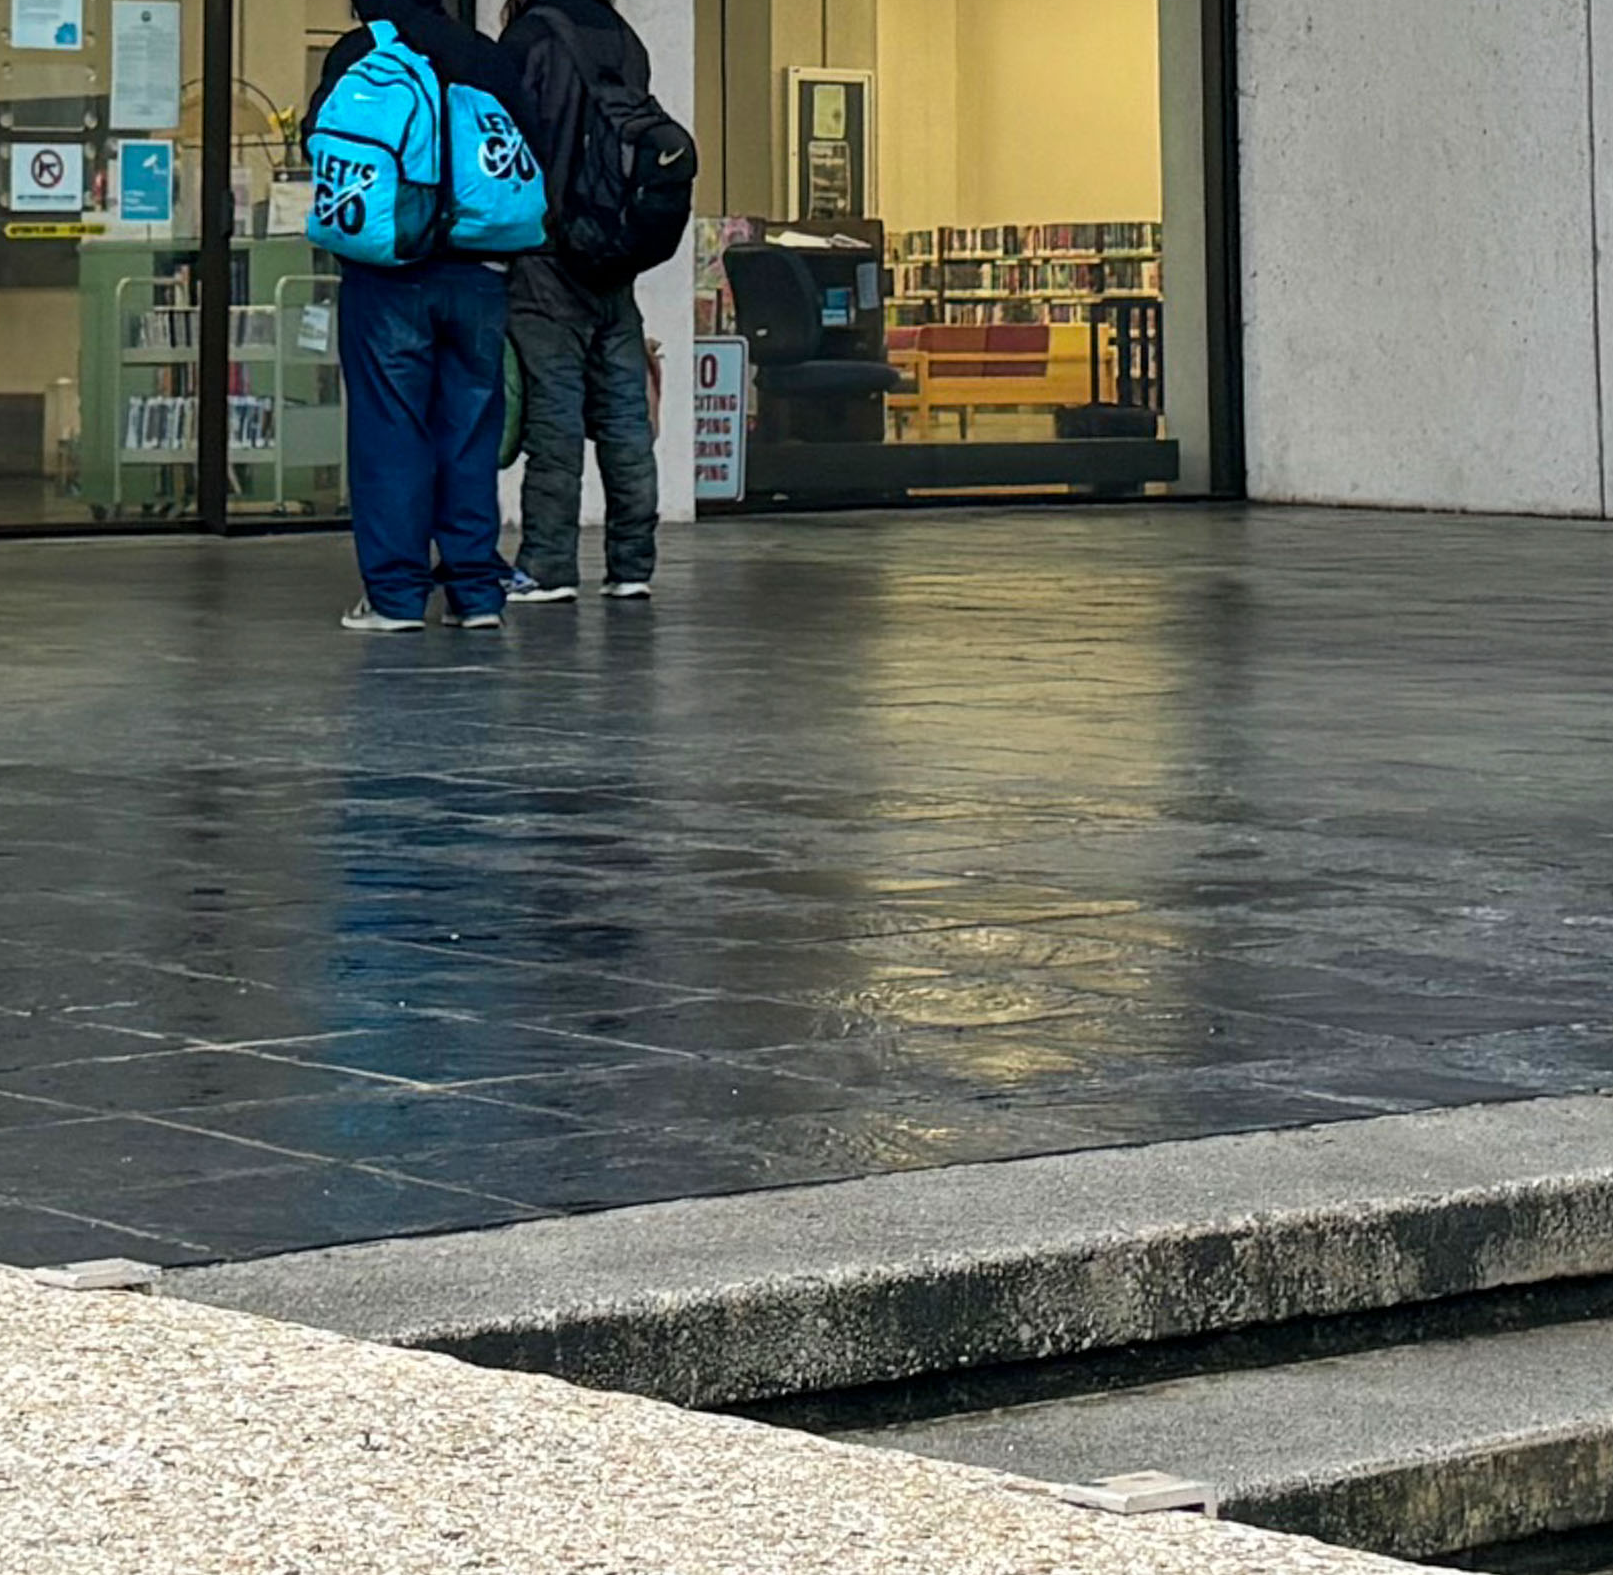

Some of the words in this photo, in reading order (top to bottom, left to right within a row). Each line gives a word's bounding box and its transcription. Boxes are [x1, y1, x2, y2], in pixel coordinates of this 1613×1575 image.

[316, 150, 378, 186] LET'S
[314, 182, 366, 236] GO
[694, 354, 717, 389] O
